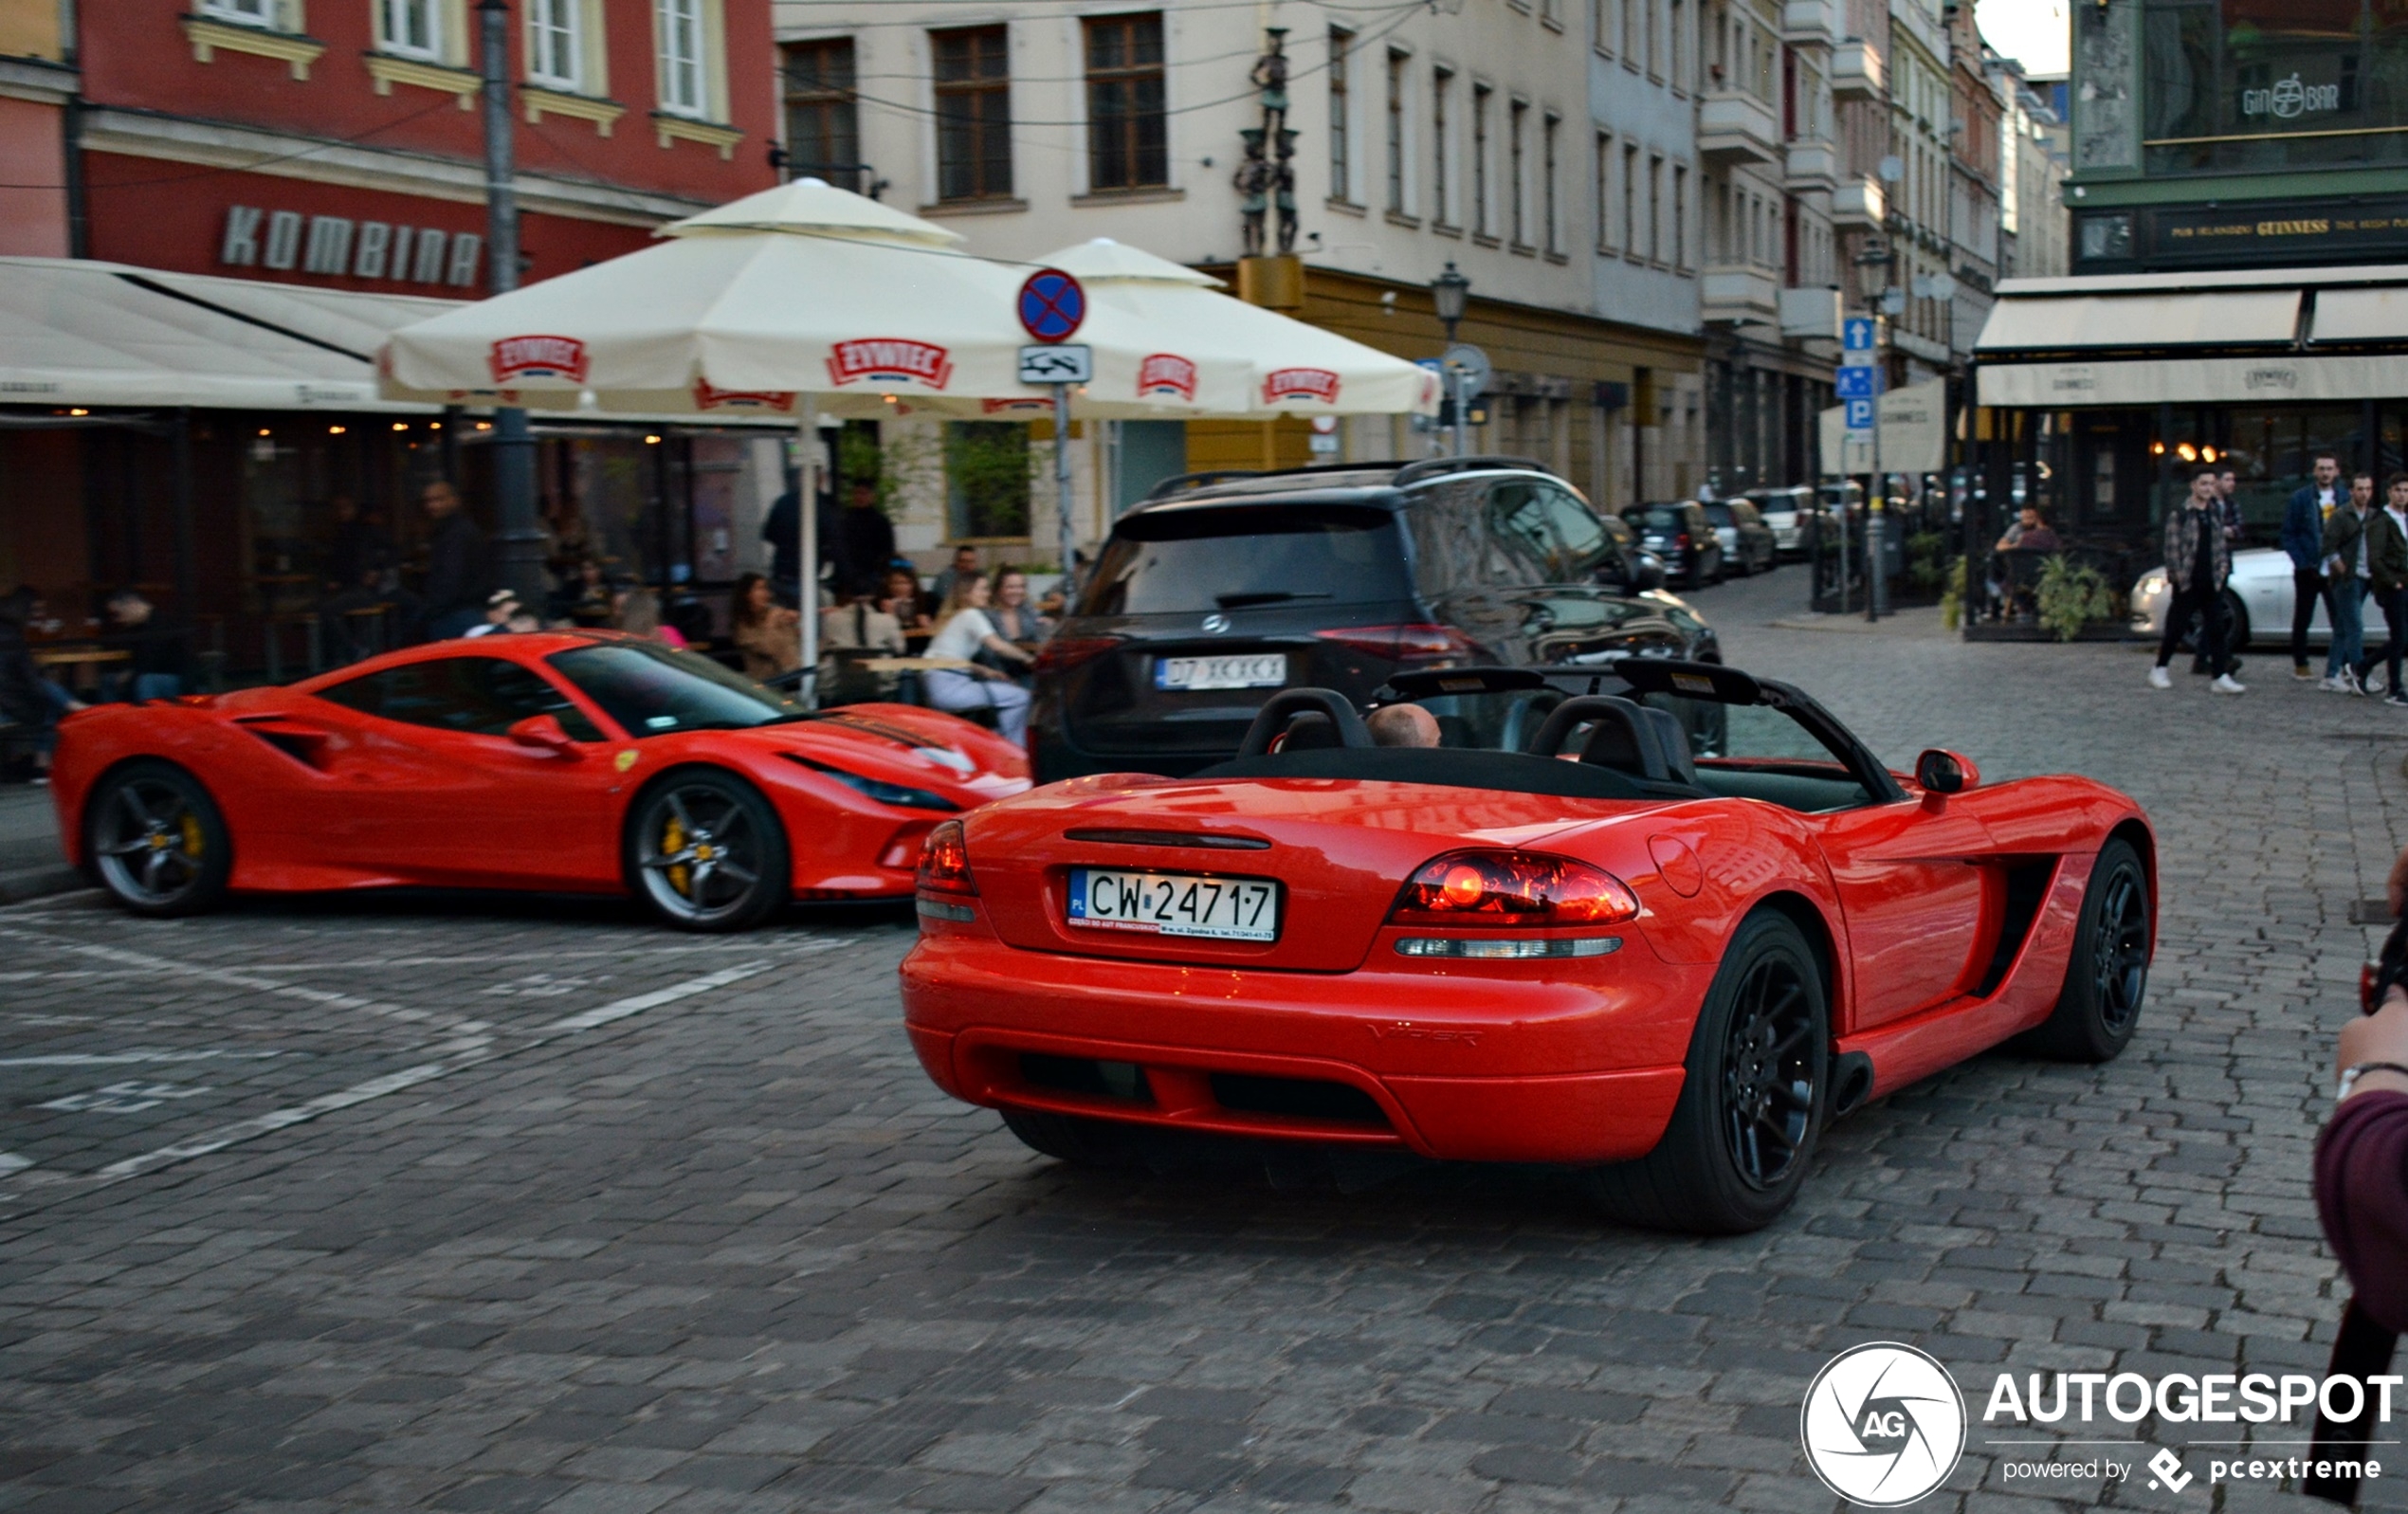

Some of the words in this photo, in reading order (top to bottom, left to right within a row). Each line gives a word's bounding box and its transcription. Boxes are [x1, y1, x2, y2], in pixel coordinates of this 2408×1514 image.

[2306, 84, 2339, 111] BAR
[2256, 219, 2330, 236] GUINNESS
[222, 205, 482, 287] KOMBINA
[1852, 400, 1870, 425] P
[1071, 899, 1085, 911] PL
[1092, 875, 1141, 919] CW
[1155, 880, 1269, 926] 24717
